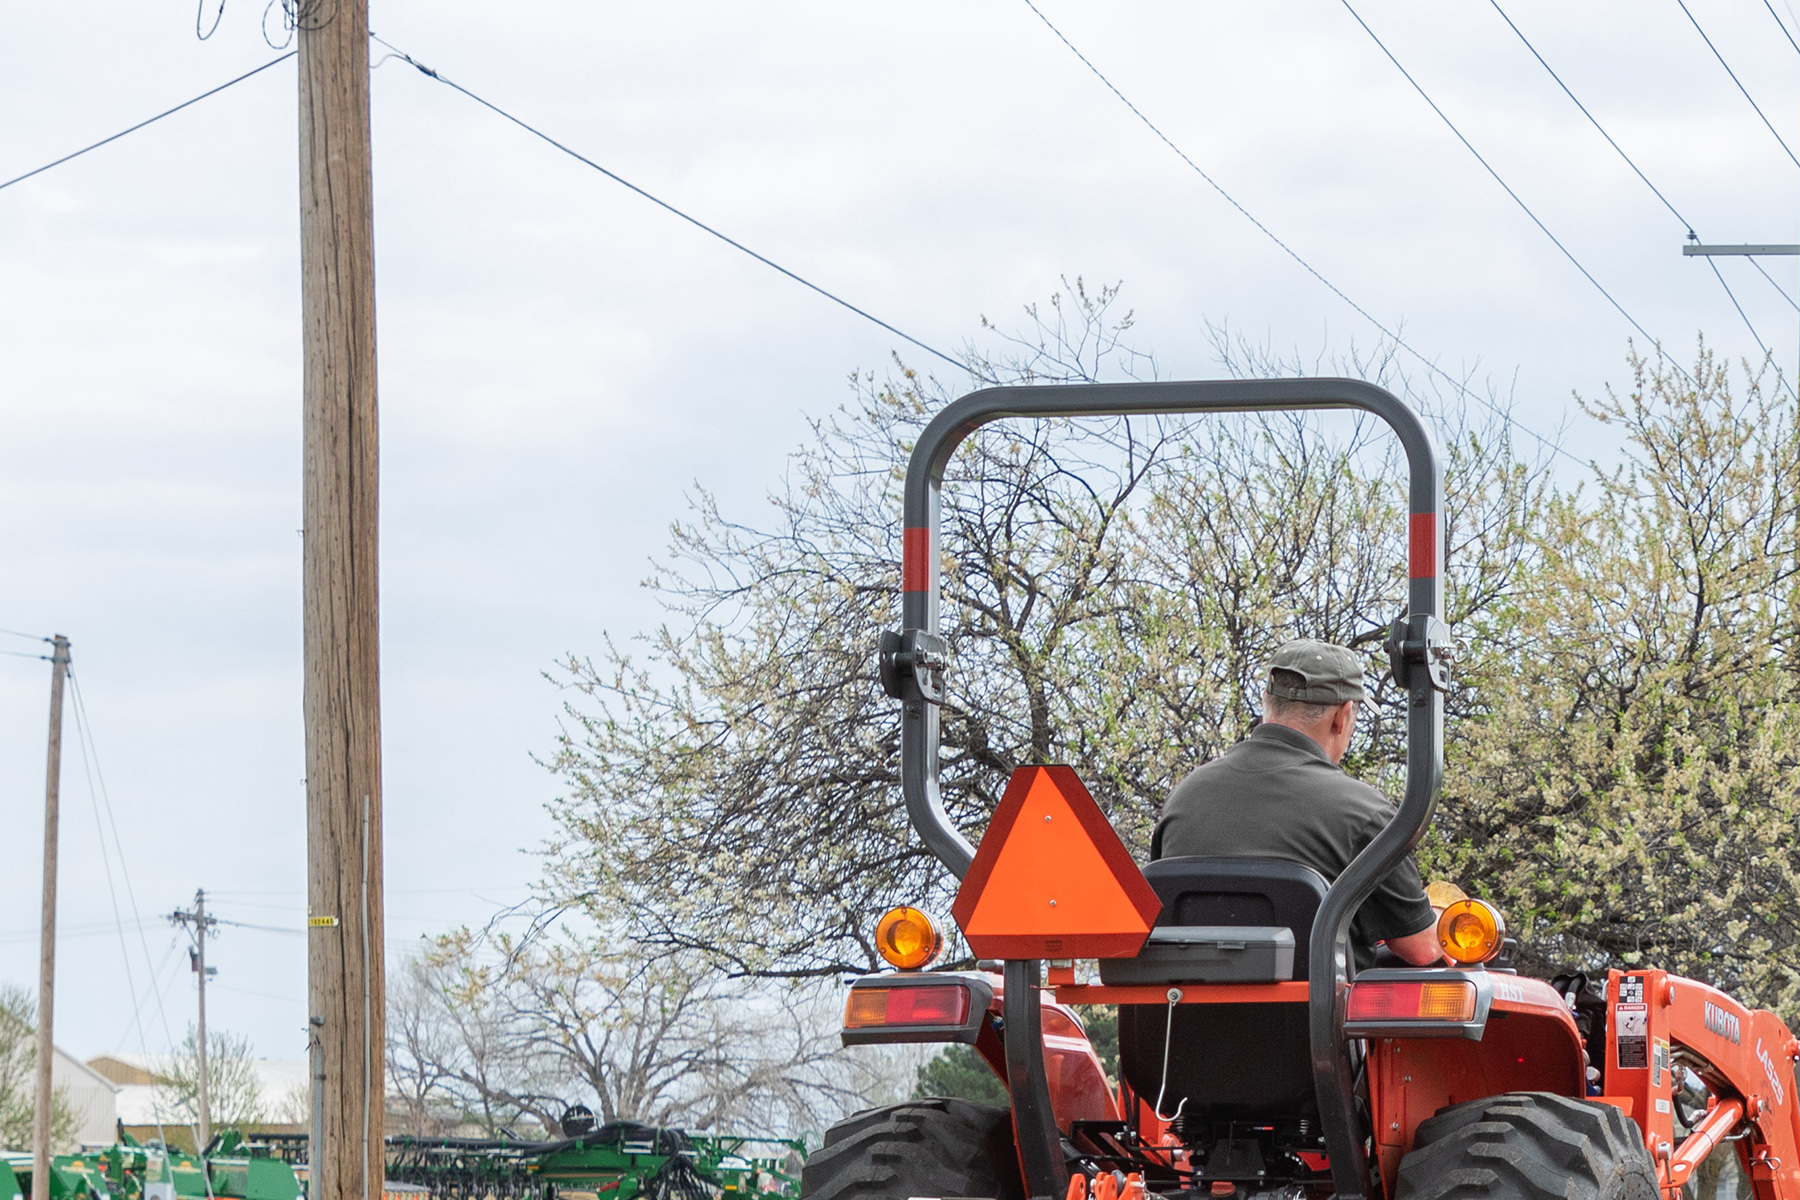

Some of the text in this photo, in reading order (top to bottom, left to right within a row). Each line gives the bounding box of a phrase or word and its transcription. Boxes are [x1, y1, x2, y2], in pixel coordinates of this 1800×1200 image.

[1499, 982, 1525, 1003] HST
[1704, 1000, 1741, 1047] KUBOTA
[1756, 1037, 1785, 1106] LA525
